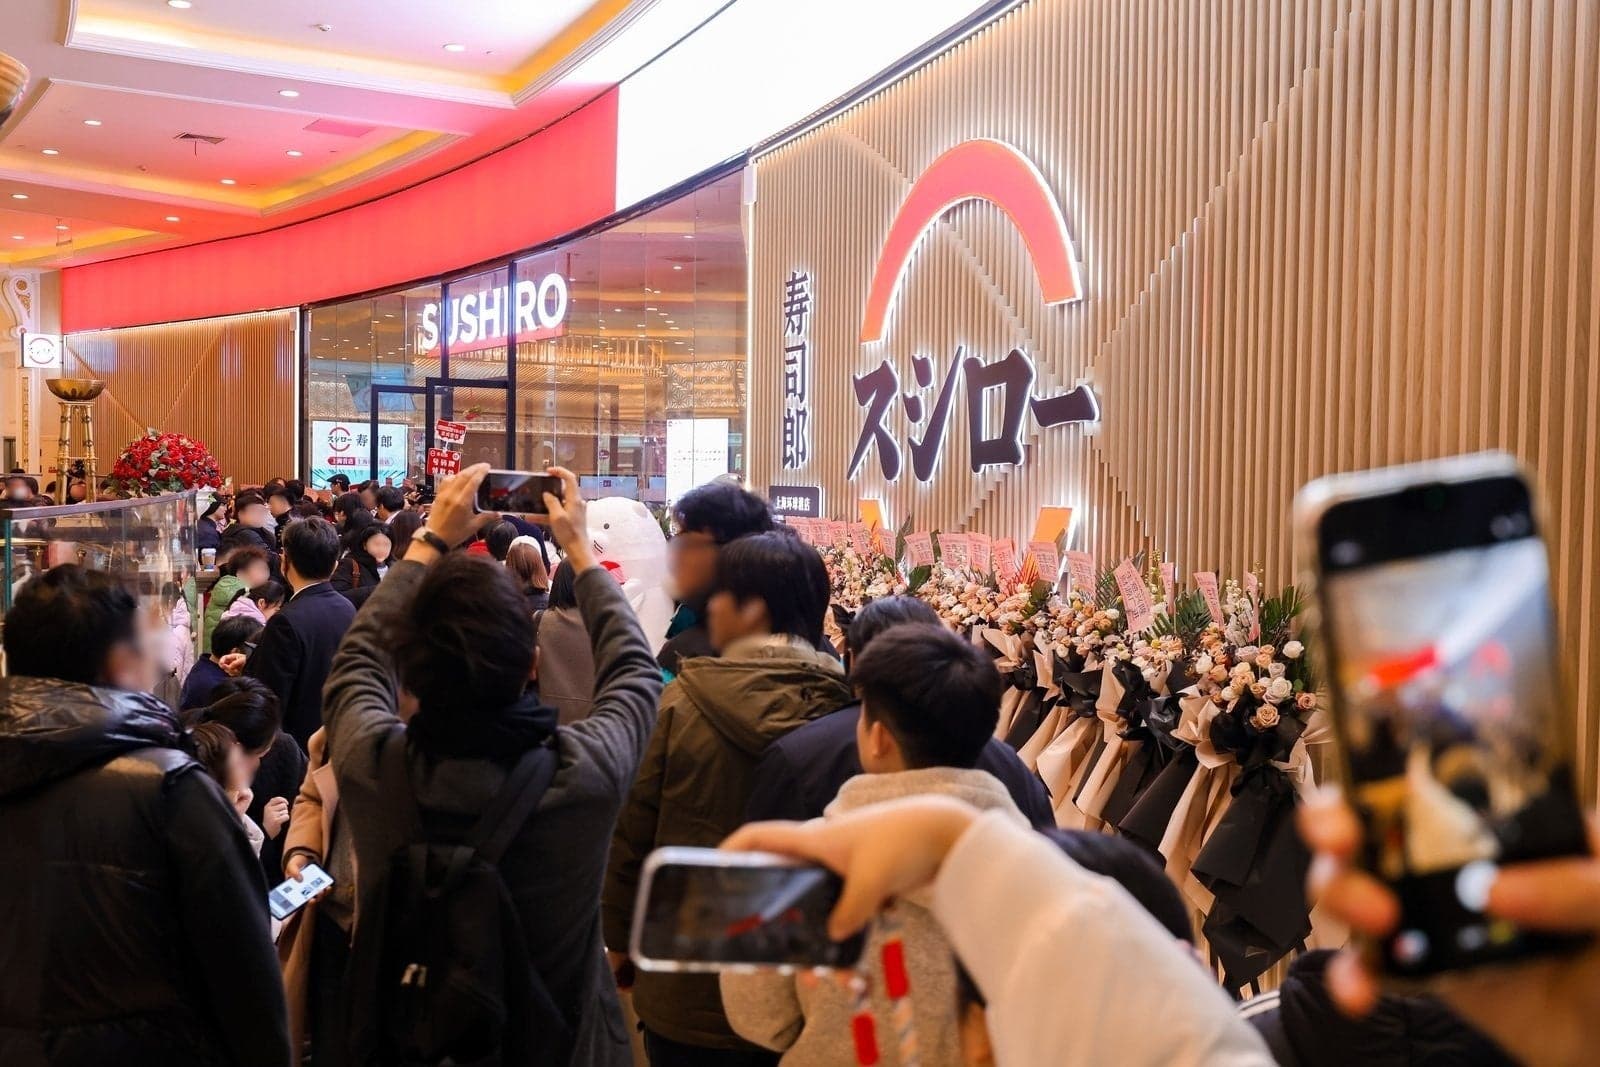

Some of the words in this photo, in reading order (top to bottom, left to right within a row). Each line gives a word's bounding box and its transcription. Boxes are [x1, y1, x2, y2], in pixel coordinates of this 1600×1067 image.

[422, 273, 568, 350] SUSHIRO
[782, 270, 811, 469] 寿司郎
[846, 345, 1100, 482] スシロー
[356, 434, 393, 448] 寿郎
